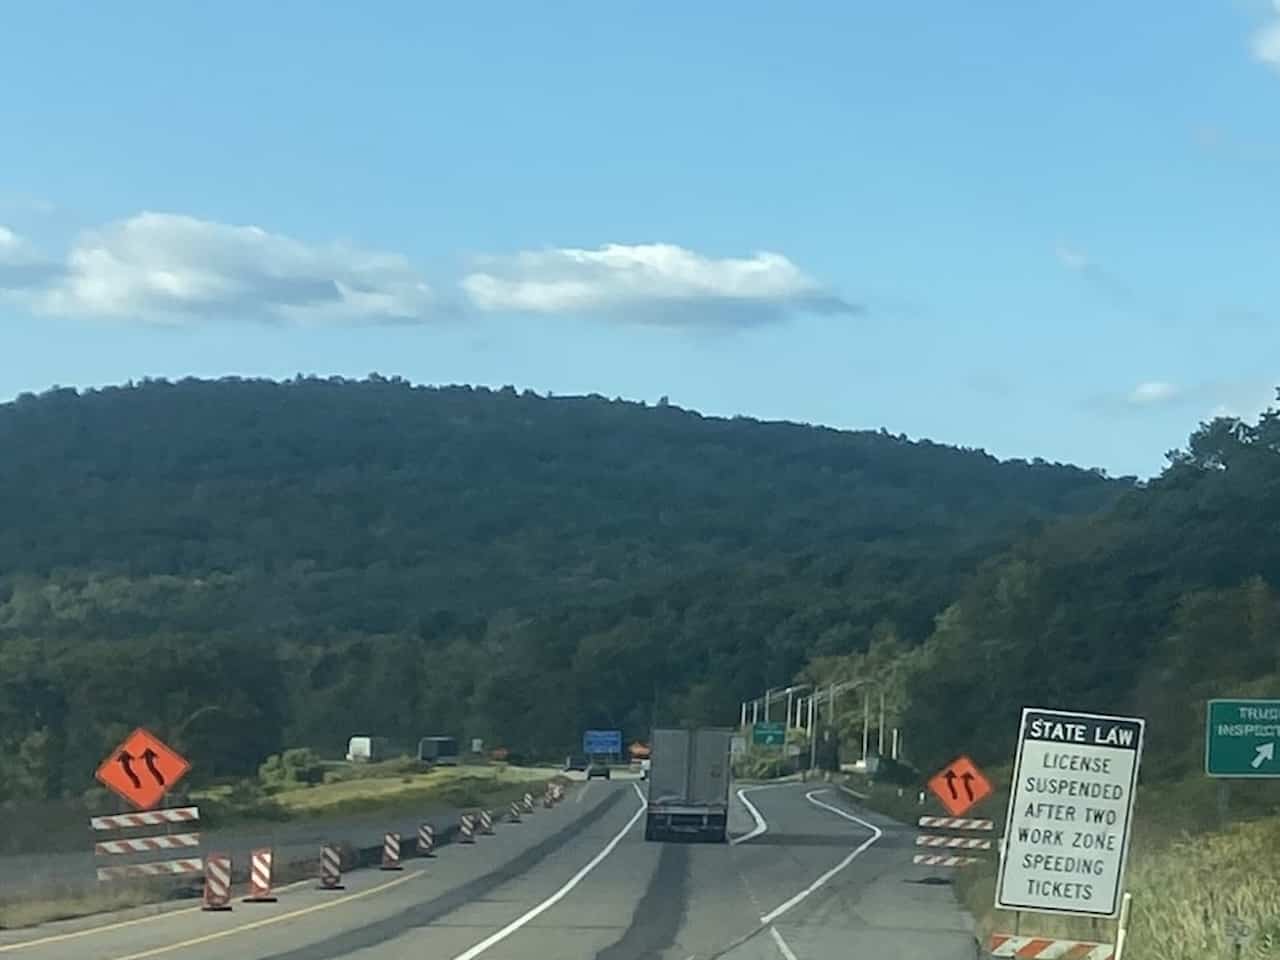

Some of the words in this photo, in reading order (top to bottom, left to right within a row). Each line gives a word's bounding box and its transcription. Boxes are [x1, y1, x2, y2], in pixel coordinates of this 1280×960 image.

[1030, 719, 1087, 742] STATE
[1095, 726, 1134, 746] LAW
[1043, 752, 1113, 775] LICENSE
[1025, 776, 1123, 801] SUSPENDED
[1024, 802, 1076, 822] AFTER
[1085, 807, 1117, 826] TWO
[1018, 827, 1064, 847] WORK
[1072, 832, 1117, 851] ZONE
[1021, 853, 1105, 876] SPEEDING
[1026, 879, 1094, 902] TICKETS
